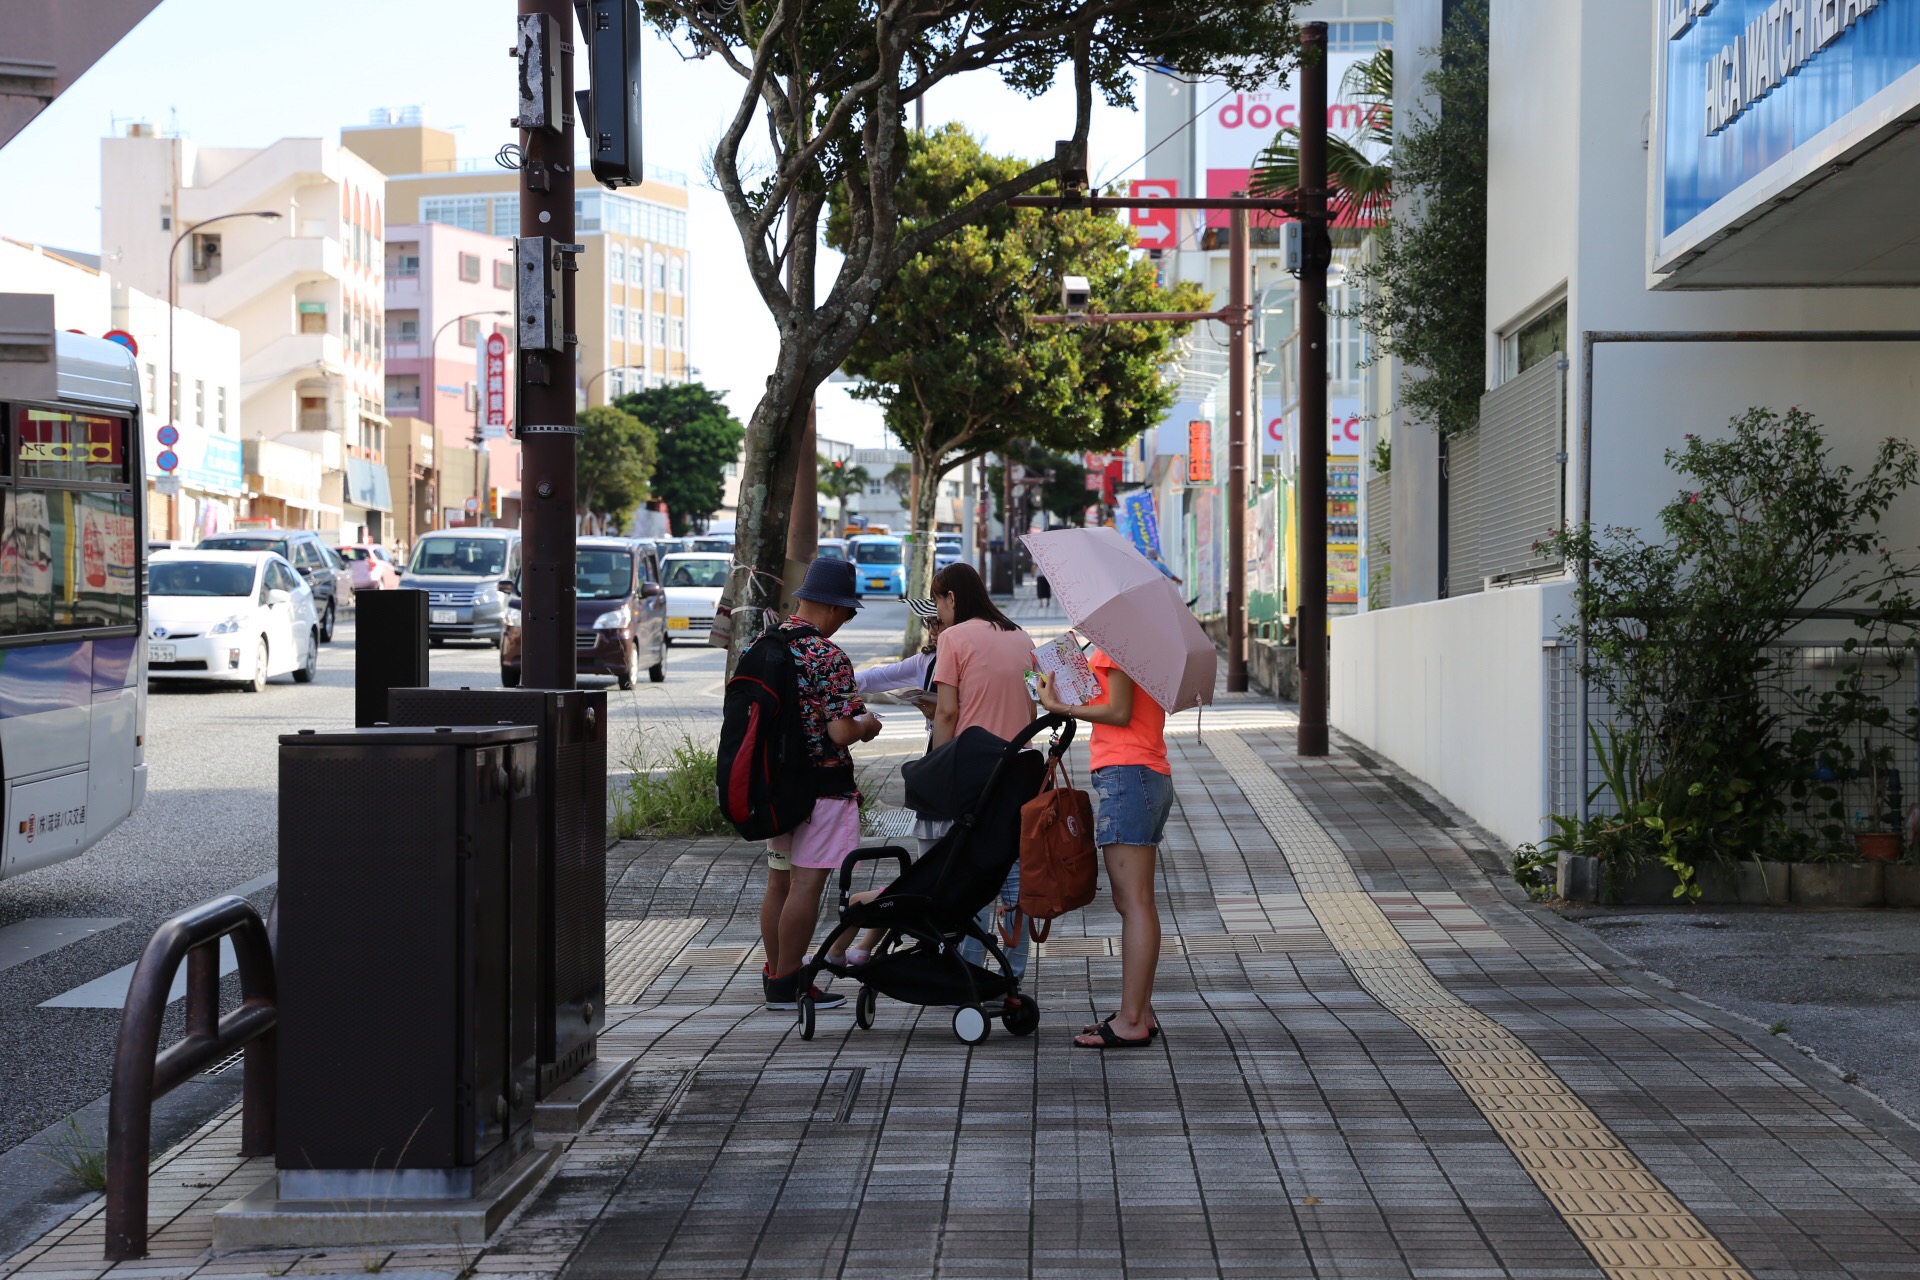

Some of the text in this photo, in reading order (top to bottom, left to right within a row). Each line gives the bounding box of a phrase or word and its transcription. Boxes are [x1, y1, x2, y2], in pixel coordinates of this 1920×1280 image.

[1218, 94, 1392, 129] docmo
[1705, 35, 1746, 137] HIGA
[1746, 0, 1810, 104] WATCH
